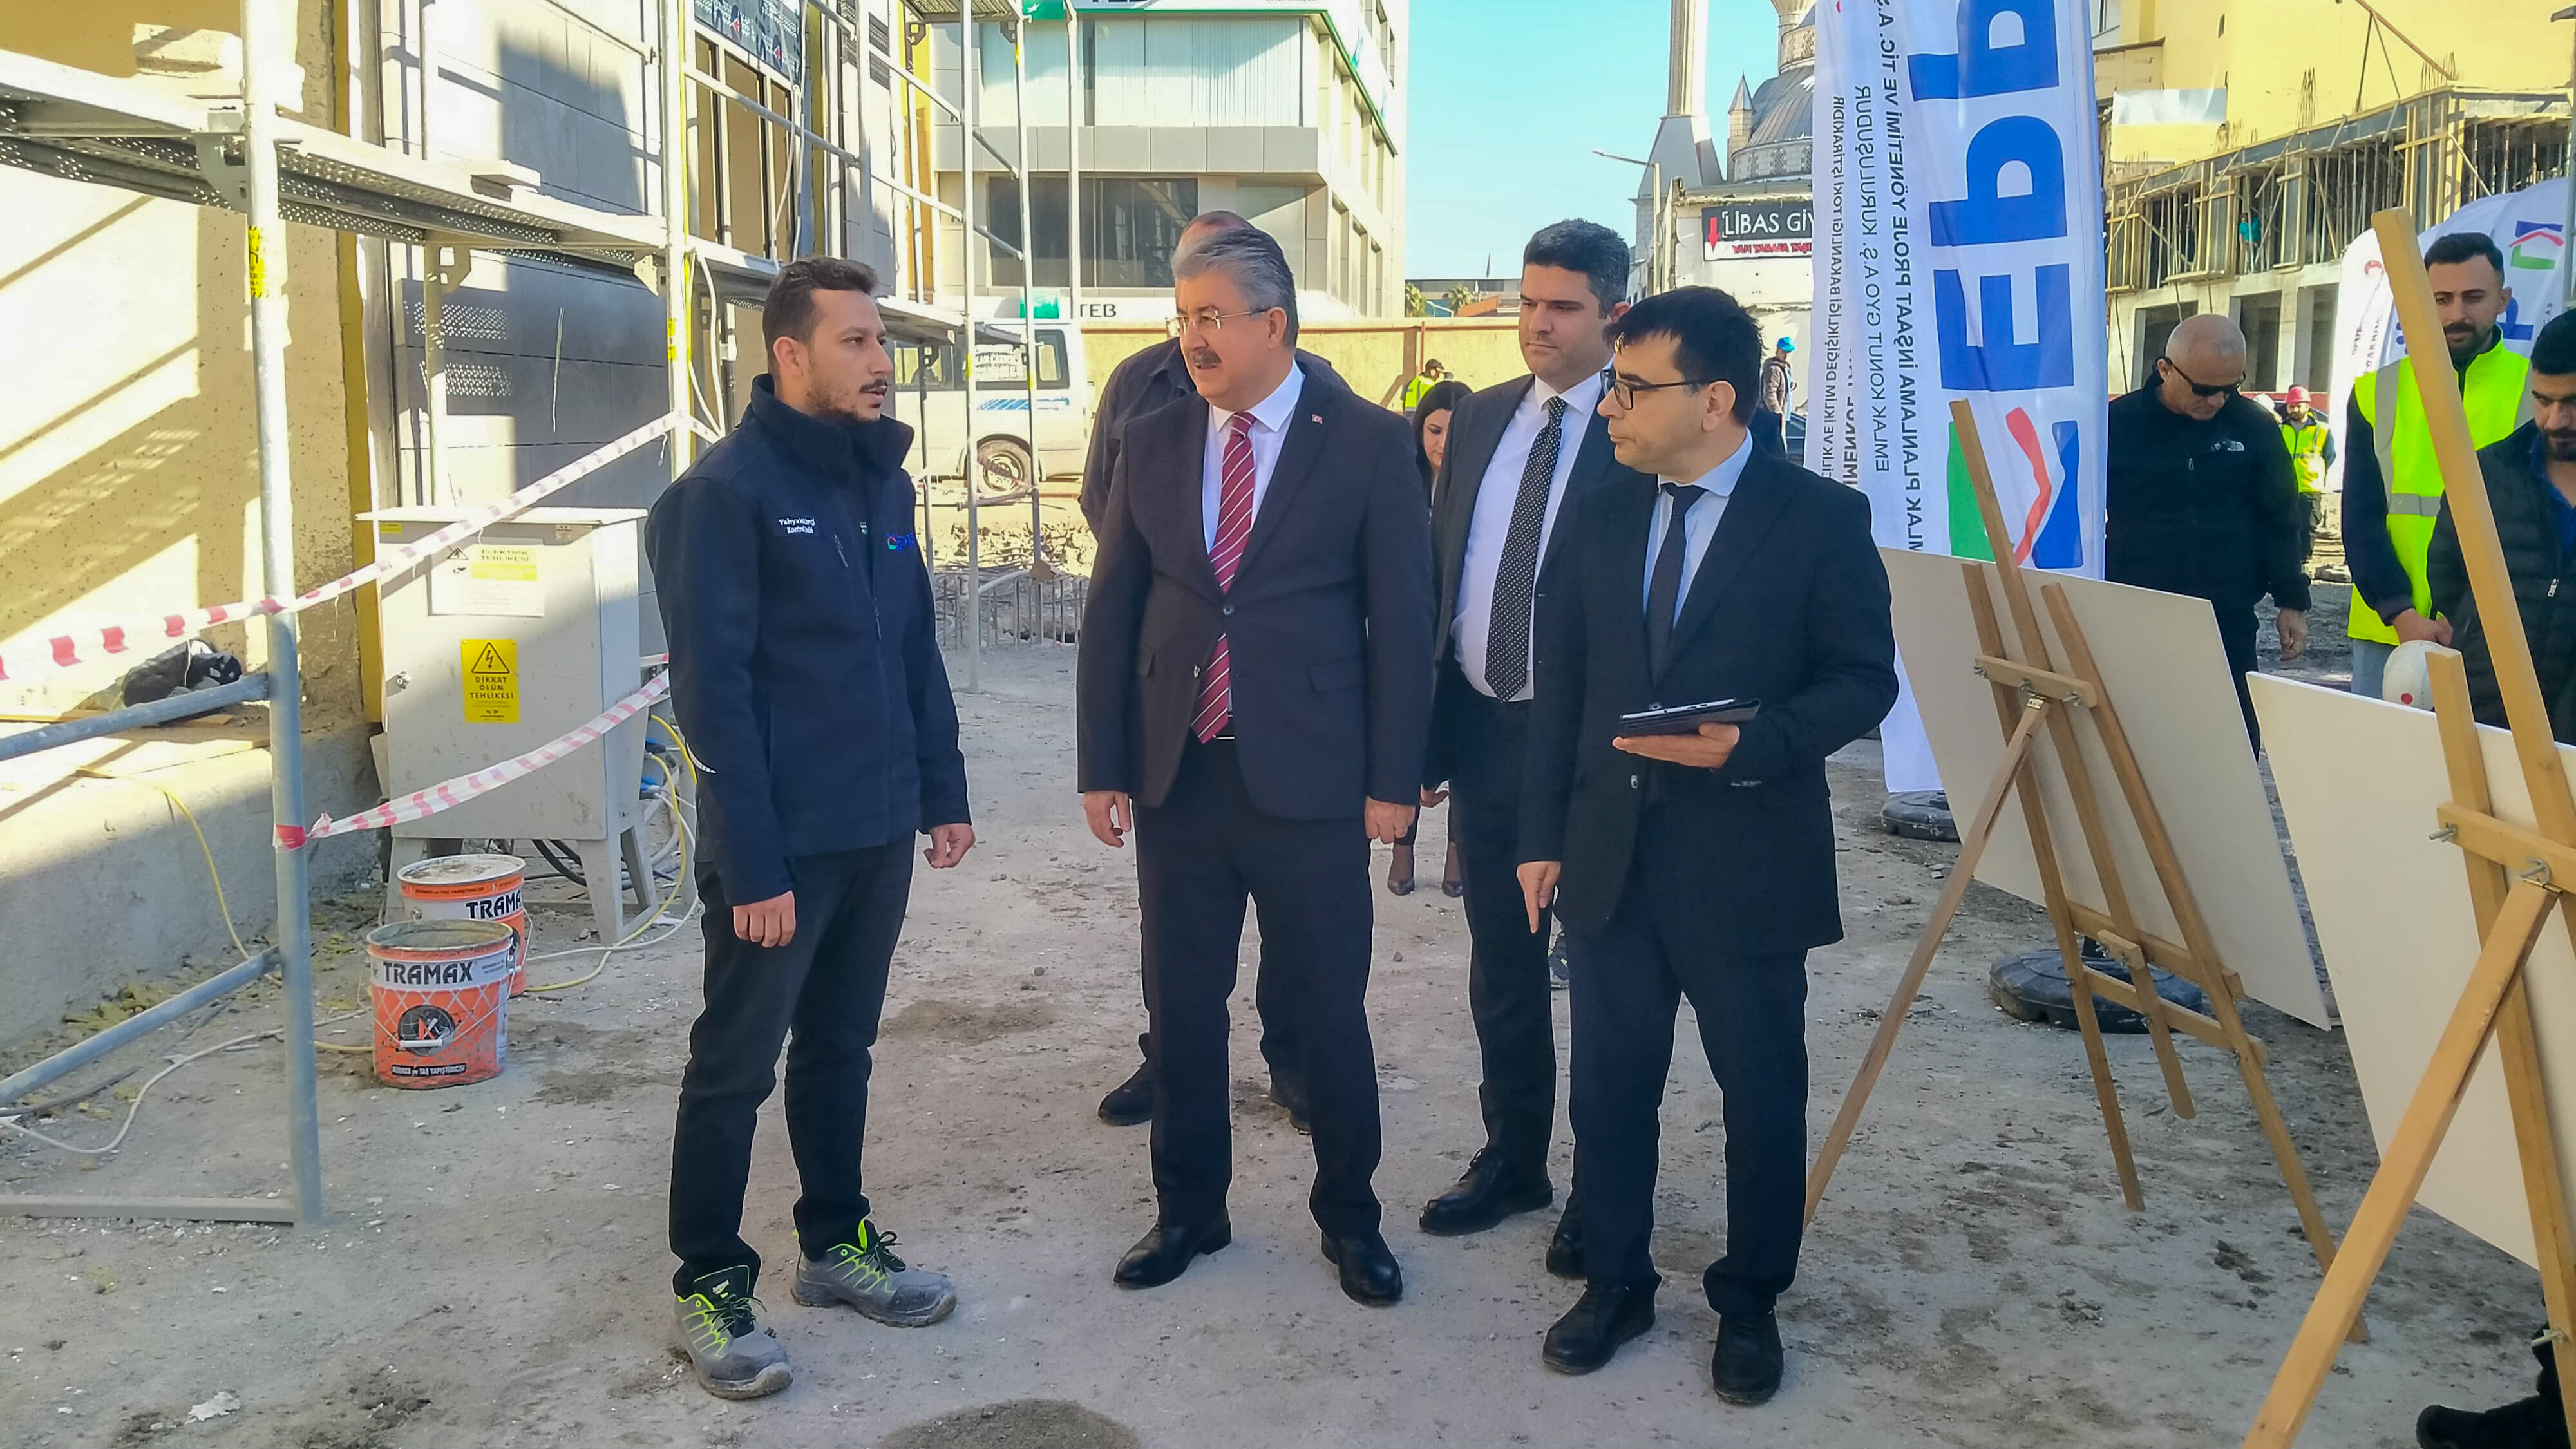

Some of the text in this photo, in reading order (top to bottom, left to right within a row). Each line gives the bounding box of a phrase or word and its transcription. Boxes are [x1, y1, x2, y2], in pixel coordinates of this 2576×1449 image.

[1725, 211, 1779, 235] LİBAS
[469, 690, 513, 699] TEHLİKESİ
[383, 961, 475, 985] TRAMAX
